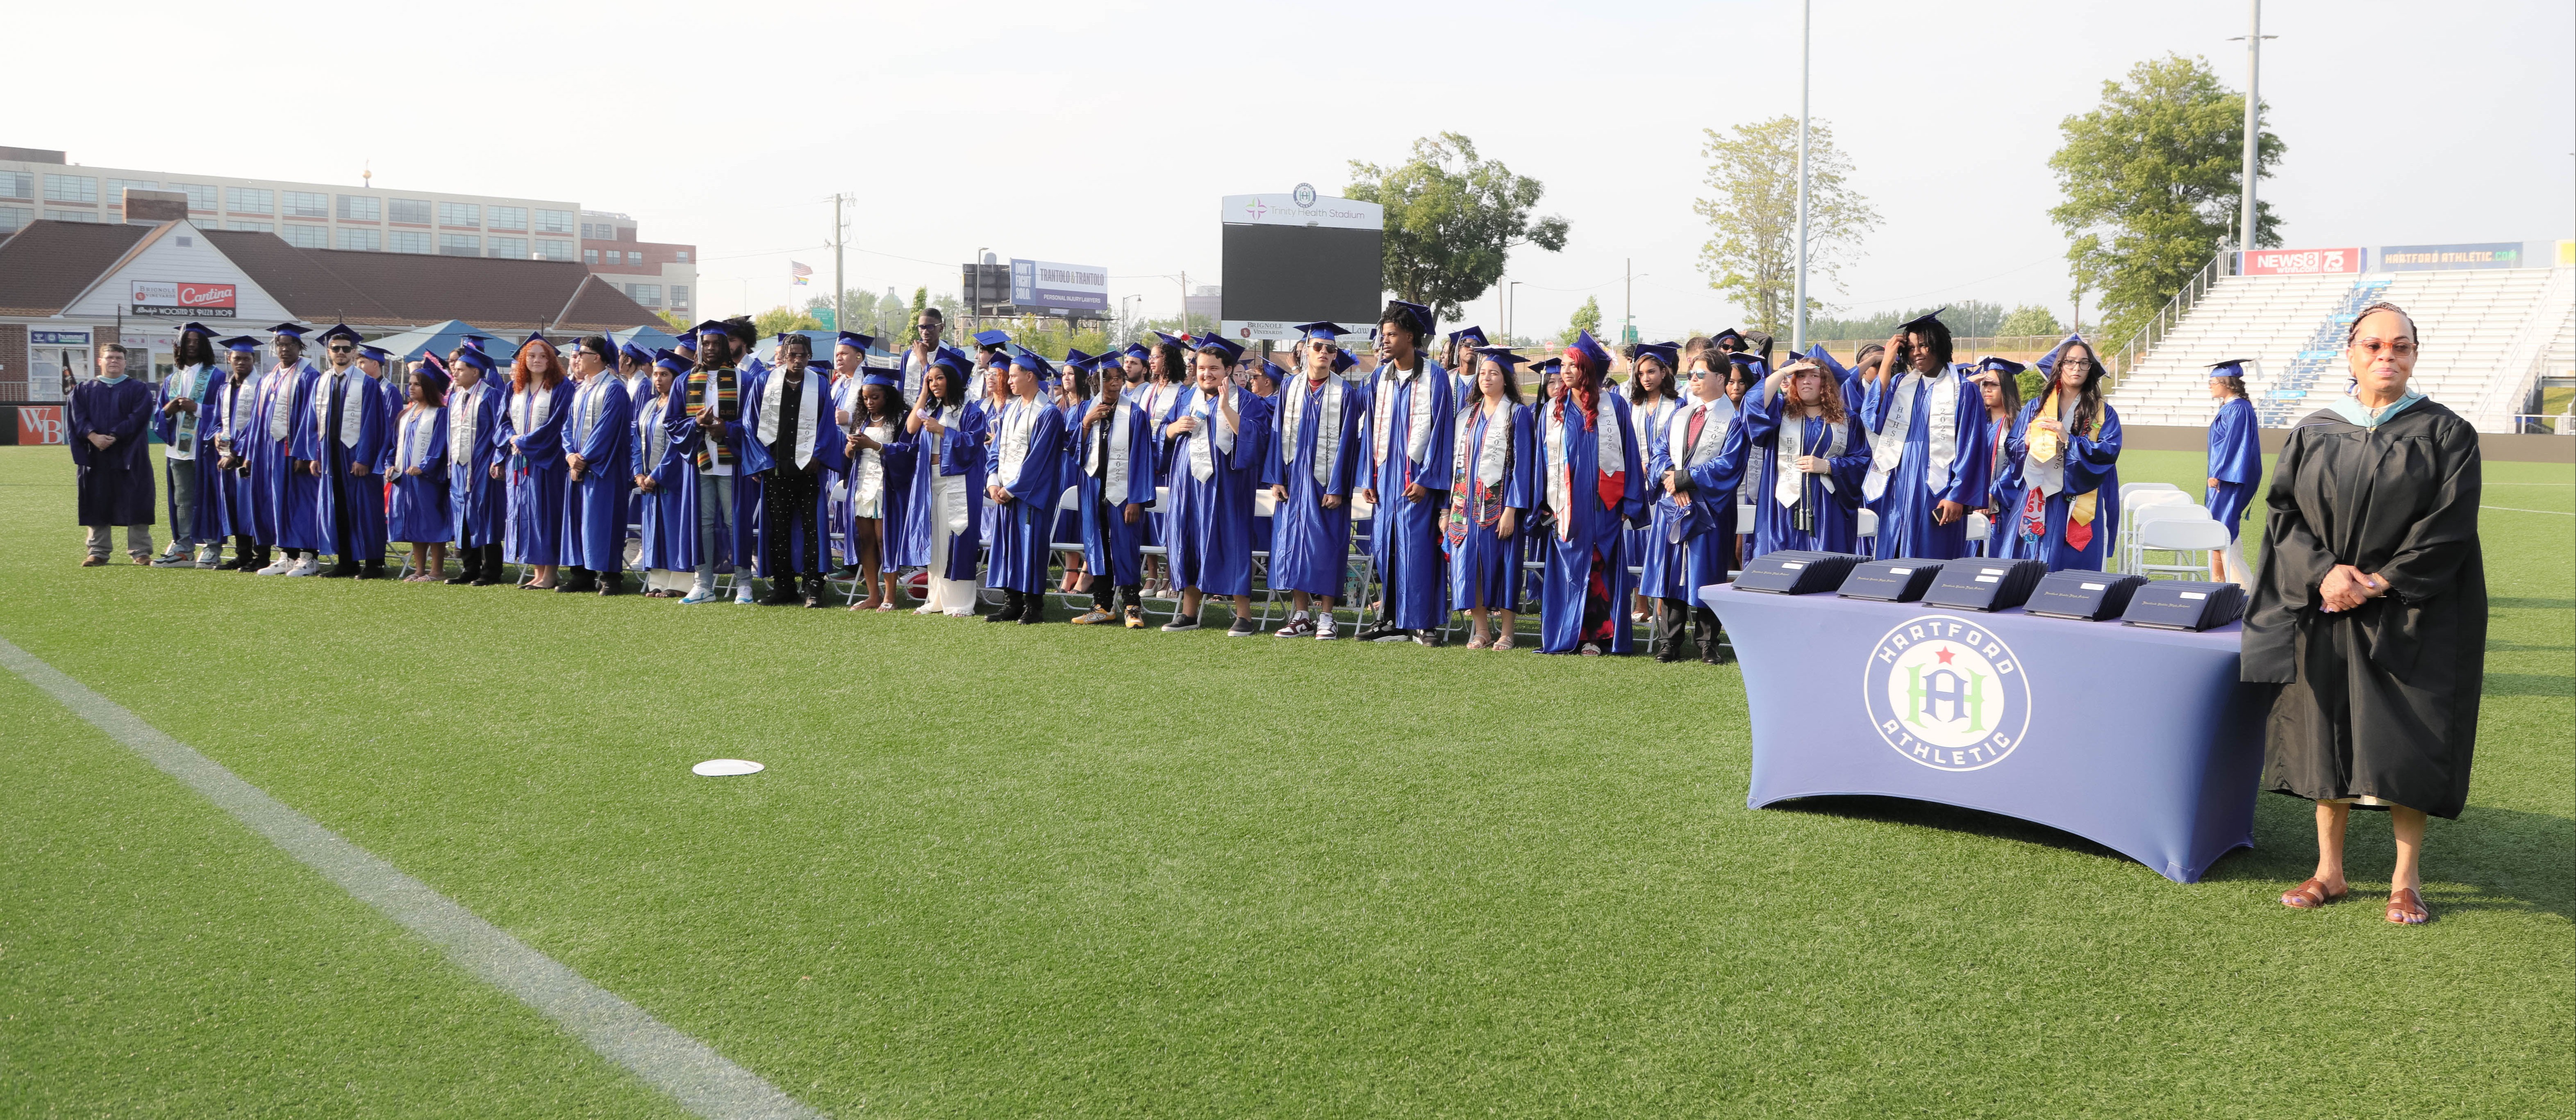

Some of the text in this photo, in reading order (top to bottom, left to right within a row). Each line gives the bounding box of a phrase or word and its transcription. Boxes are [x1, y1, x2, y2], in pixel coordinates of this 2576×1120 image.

[1270, 206, 1365, 219] Trinity Health Stadium
[2323, 251, 2344, 268] 75
[2385, 253, 2438, 264] HARTFORD
[1015, 262, 1031, 275] DON'T
[1016, 275, 1031, 287] FIGHT
[1040, 269, 1104, 286] TRANTOLO & TRANTOLO
[181, 287, 232, 304] Cantina
[1016, 288, 1030, 300] SOLO.
[1351, 325, 1369, 334] Law
[1890, 406, 1904, 437] HPHS
[1491, 432, 1500, 461] 2025
[1705, 426, 1719, 456] 2025
[1879, 621, 2014, 674] HARTFORD
[1883, 719, 2010, 765] ATHLETIC
